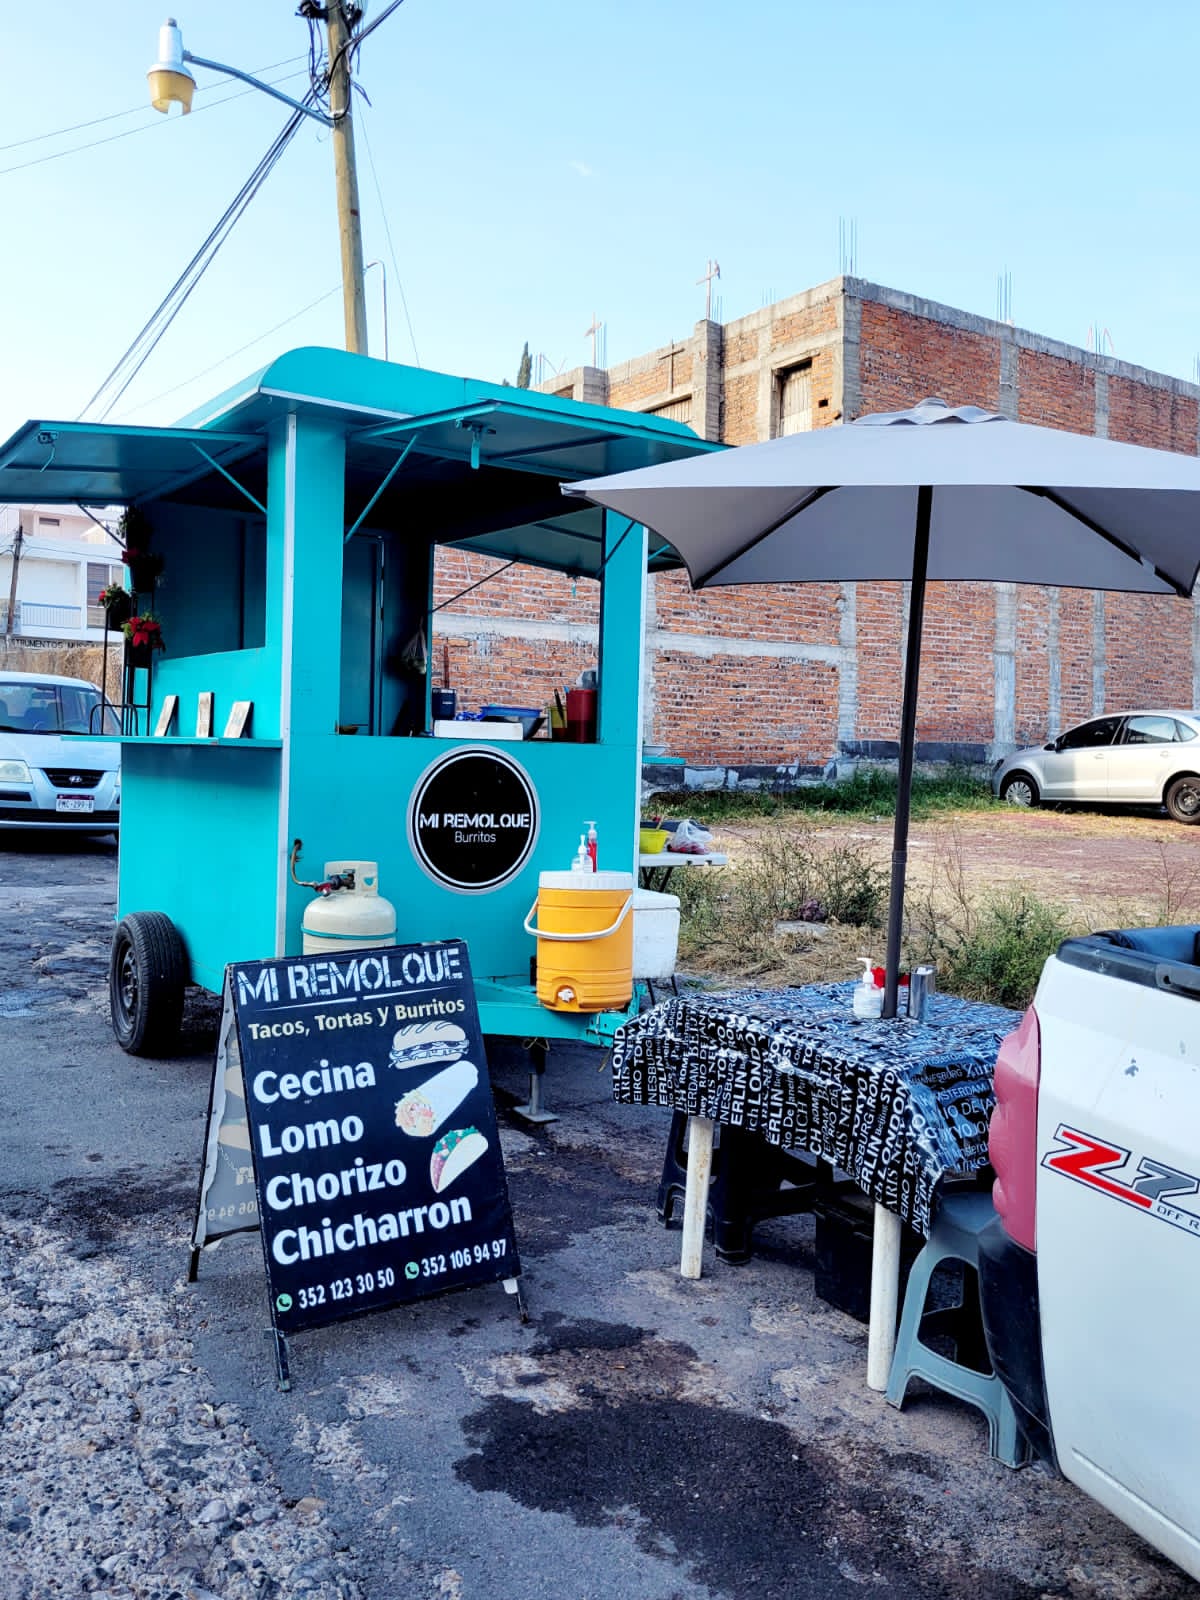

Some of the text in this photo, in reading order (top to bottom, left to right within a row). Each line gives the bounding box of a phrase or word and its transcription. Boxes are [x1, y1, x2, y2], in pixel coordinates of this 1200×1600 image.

[420, 813, 530, 829] MI REMOLQUE
[454, 831, 497, 843] Burritos
[237, 948, 464, 1005] MI REMOLQUE
[248, 1018, 309, 1041] Tacos,
[314, 1009, 374, 1031] Tortas
[395, 999, 466, 1022] Burritos
[252, 1058, 377, 1104] Cecina
[621, 1066, 631, 1104] ARIS
[258, 1114, 365, 1158] Lomo
[266, 1157, 408, 1211] Chorizo
[271, 1194, 473, 1266] Chicharron
[1156, 1205, 1184, 1221] OFF
[422, 1239, 507, 1278] 352 106 94 97
[298, 1266, 395, 1310] 352 123 30 50
